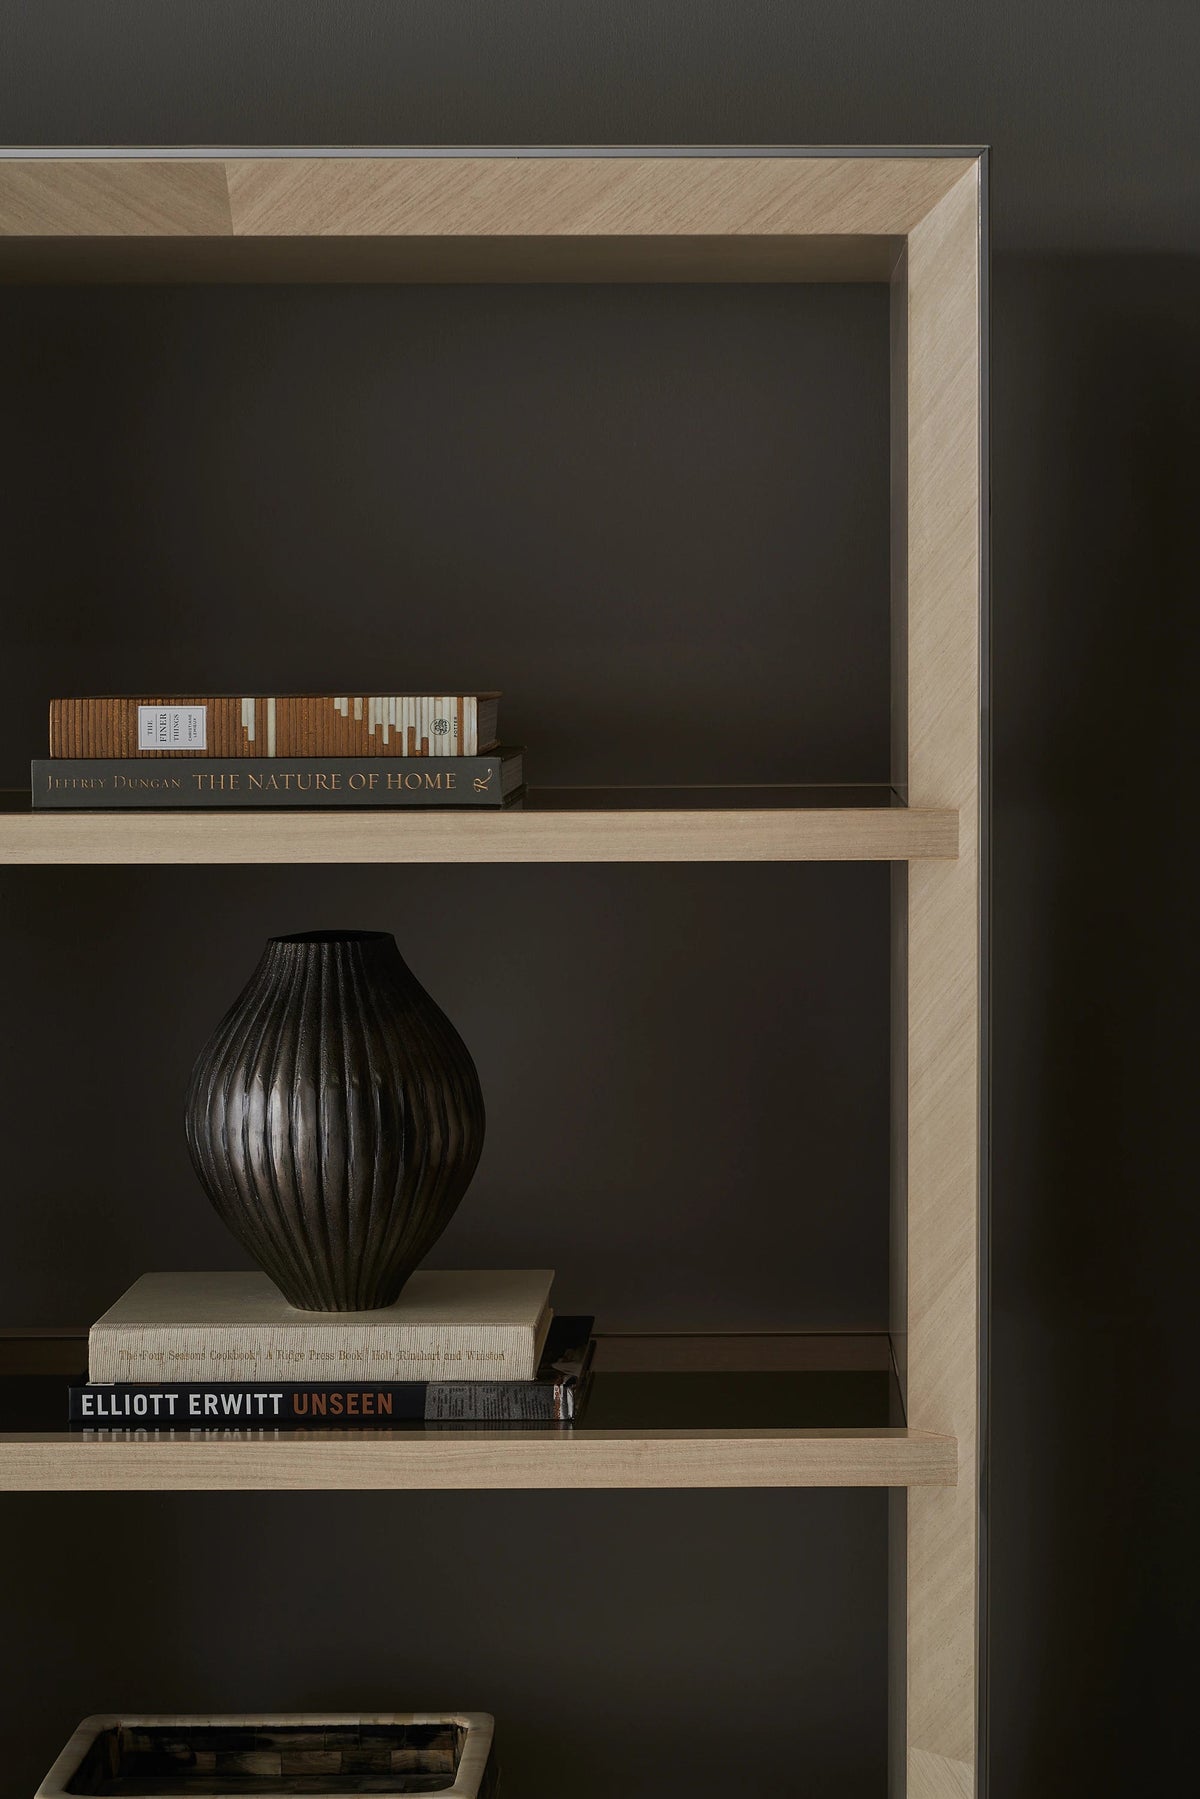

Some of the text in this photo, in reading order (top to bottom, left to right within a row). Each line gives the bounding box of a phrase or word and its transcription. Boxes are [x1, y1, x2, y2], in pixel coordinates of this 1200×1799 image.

[159, 713, 167, 742] FINER
[47, 775, 181, 791] JEFFREY DUNGAN
[193, 773, 457, 790] THE NATURE OF HOME
[118, 1350, 138, 1361] The
[142, 1350, 165, 1361] Four
[209, 1350, 256, 1361] Cookbook
[265, 1350, 363, 1362] A Ridge Press Book
[444, 1350, 462, 1361] and
[466, 1350, 505, 1361] Winston
[81, 1392, 393, 1415] ELLIOTT ERWITT UNSEEN
